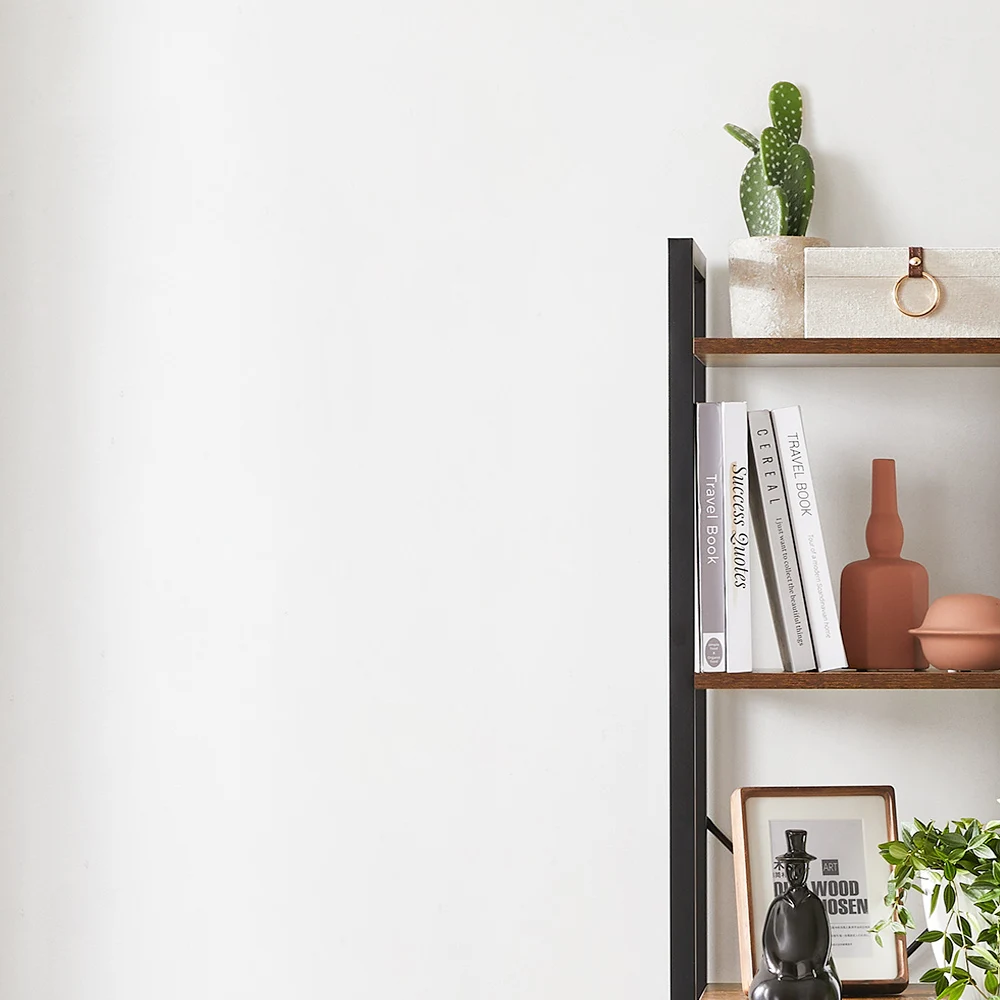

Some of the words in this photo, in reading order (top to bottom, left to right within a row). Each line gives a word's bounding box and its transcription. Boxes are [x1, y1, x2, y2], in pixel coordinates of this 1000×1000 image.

[757, 429, 780, 504] CEREAL
[787, 432, 804, 479] TRAVEL
[796, 483, 812, 516] BOOK
[705, 474, 718, 519] Travel
[731, 464, 747, 526] Success
[775, 521, 784, 534] just
[706, 525, 719, 564] Book
[779, 535, 787, 552] want
[730, 532, 749, 589] Quotes
[782, 552, 788, 560] to
[783, 560, 793, 582] collect
[787, 583, 795, 595] the
[790, 595, 801, 625] beautiful
[795, 625, 804, 647] things
[823, 862, 838, 873] ART
[811, 880, 859, 897] WOOD
